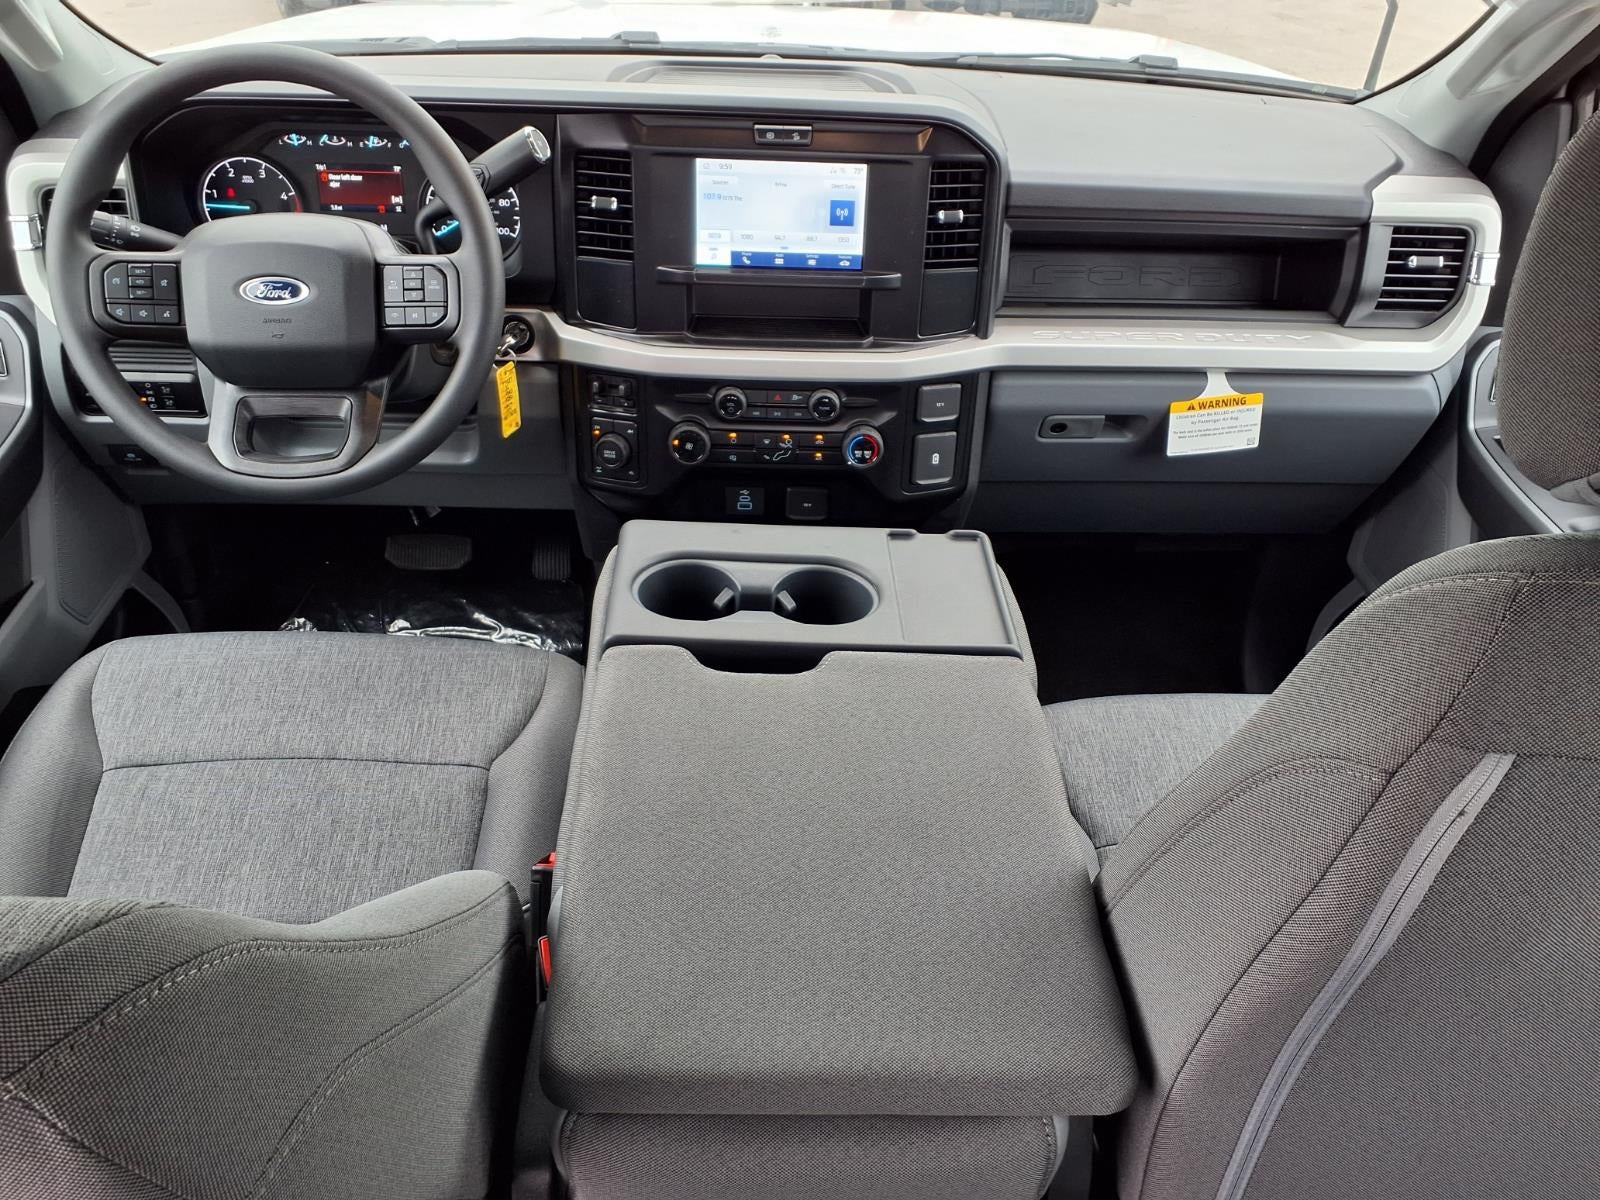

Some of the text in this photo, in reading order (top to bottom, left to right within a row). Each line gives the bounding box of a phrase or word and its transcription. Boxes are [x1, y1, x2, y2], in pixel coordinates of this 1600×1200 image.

[228, 168, 235, 177] 2
[258, 169, 266, 178] 3
[211, 189, 218, 199] 1
[280, 191, 288, 200] 4
[498, 198, 511, 207] 80
[1032, 264, 1241, 288] FORD
[256, 281, 292, 299] Ford
[1032, 329, 1314, 343] SUPER DUTY
[1197, 395, 1247, 411] WARNING
